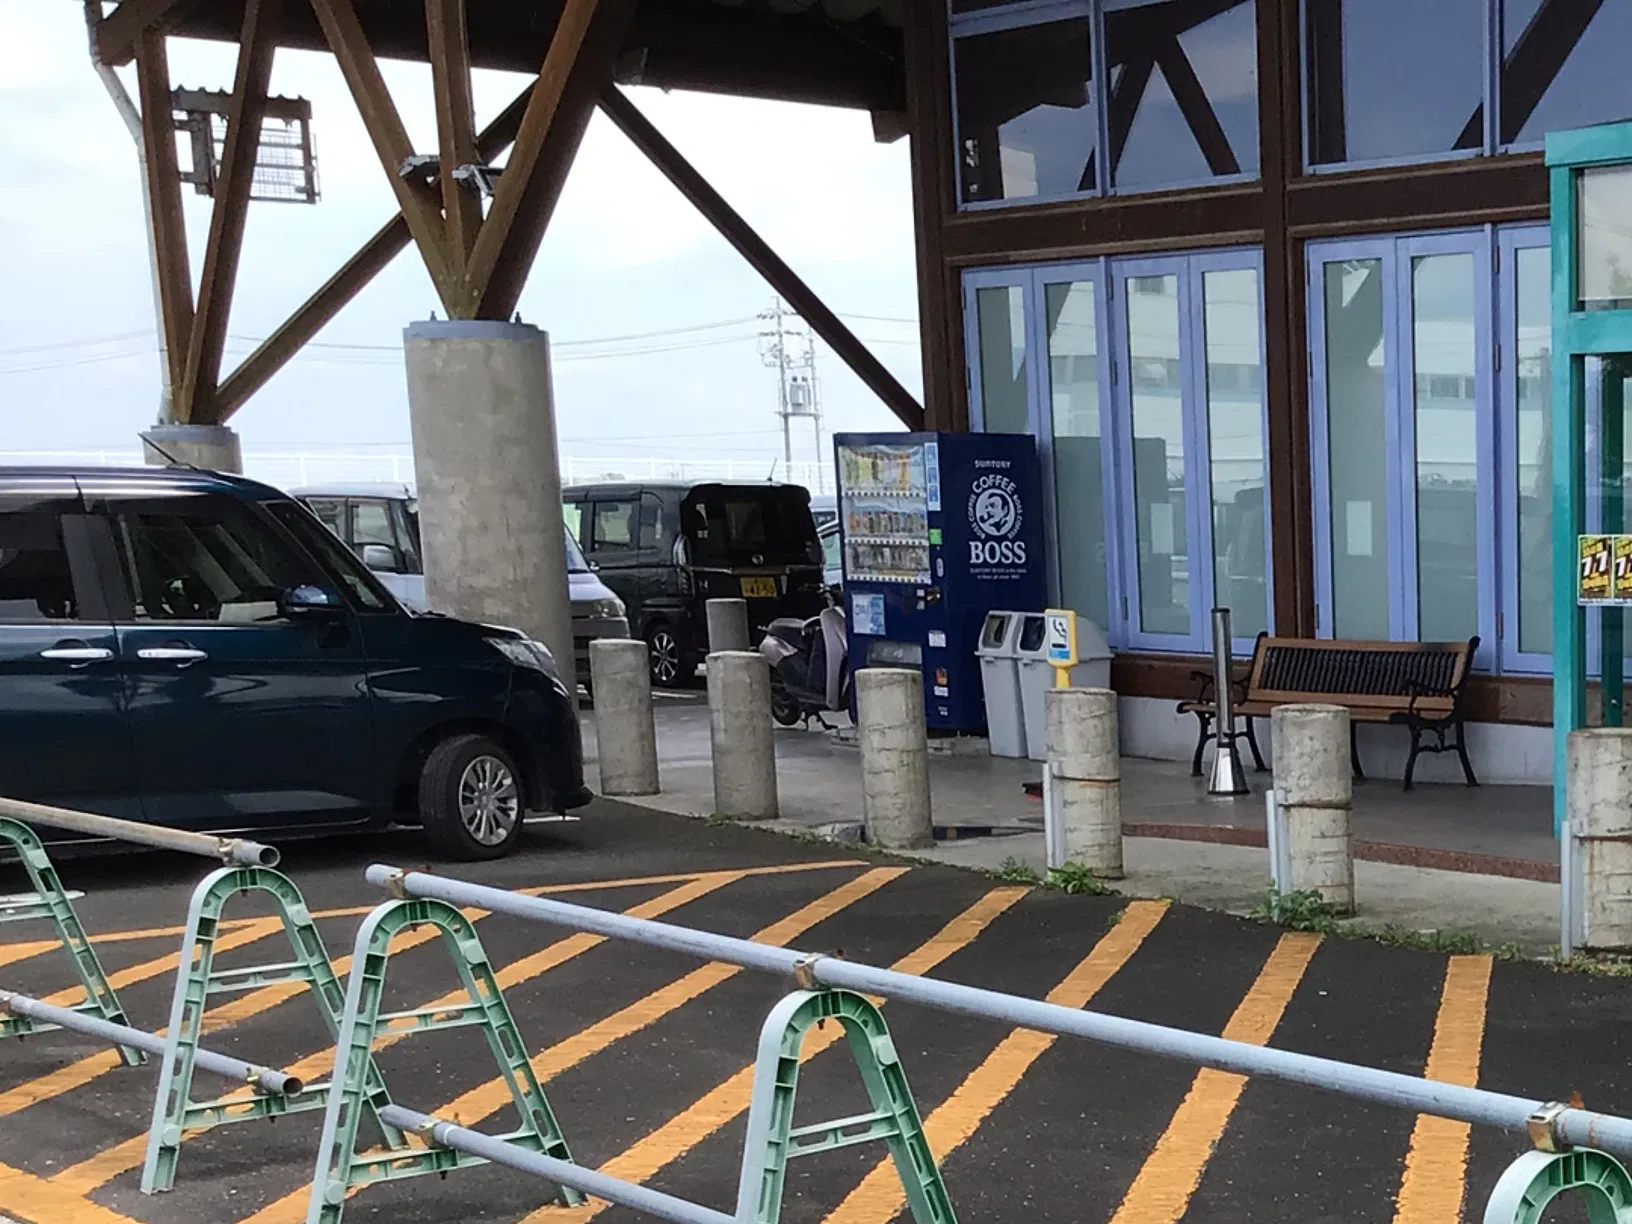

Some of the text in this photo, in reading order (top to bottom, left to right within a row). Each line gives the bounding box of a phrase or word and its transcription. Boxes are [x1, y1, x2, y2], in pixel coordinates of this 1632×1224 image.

[974, 460, 1011, 468] SUNTORY
[972, 474, 1017, 495] COFFEE
[968, 541, 1026, 564] BOSS
